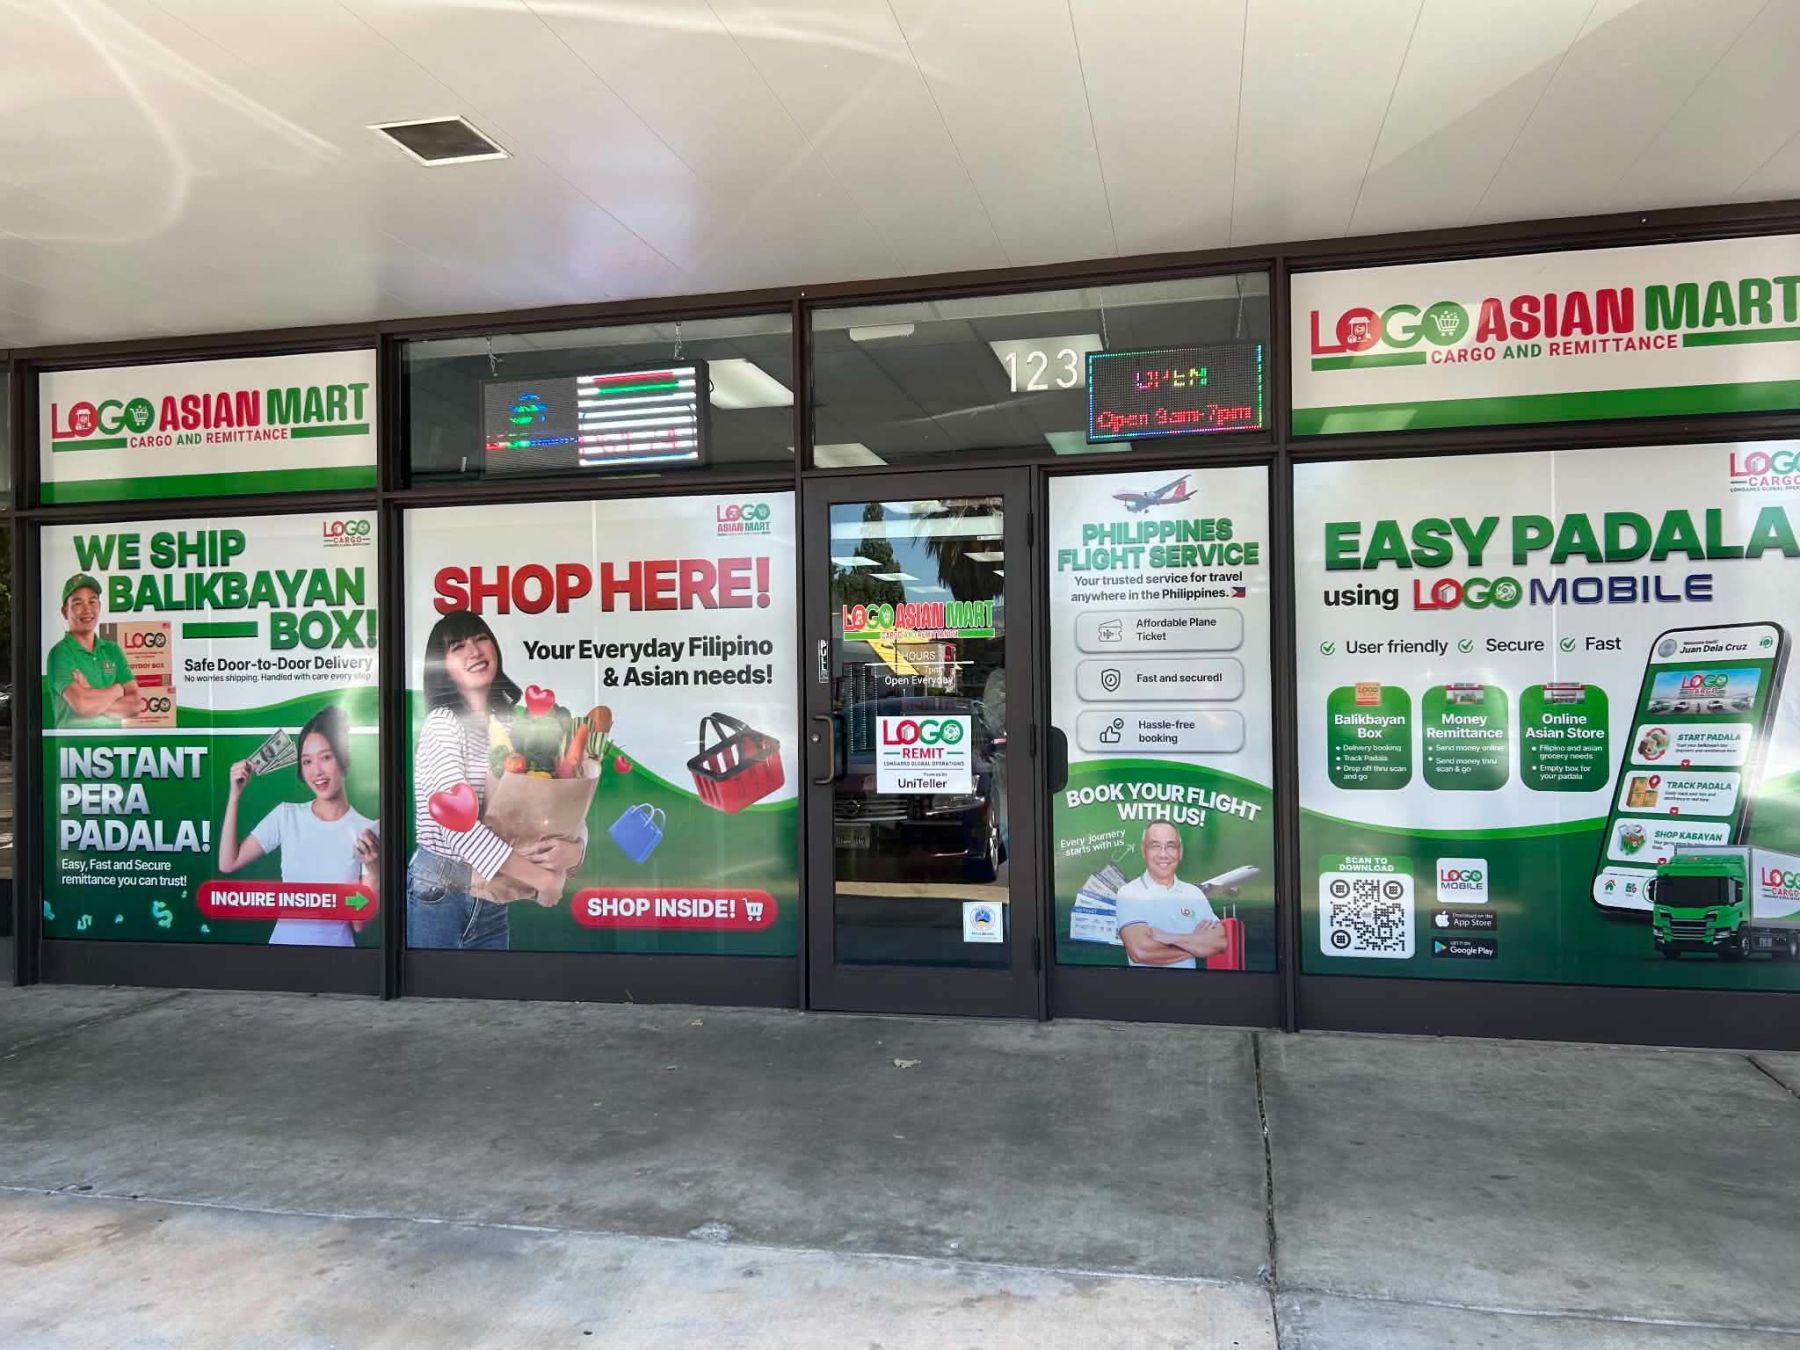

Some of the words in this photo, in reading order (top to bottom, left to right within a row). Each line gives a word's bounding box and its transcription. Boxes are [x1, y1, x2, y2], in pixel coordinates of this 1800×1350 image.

[1311, 300, 1470, 356] LOGO
[1475, 286, 1634, 344] ASIAN
[1644, 276, 1800, 331] MART
[1431, 346, 1496, 364] CARGO
[1502, 344, 1542, 360] AND
[1549, 334, 1678, 357] REMITTANCE
[1006, 349, 1078, 392] 123
[52, 398, 155, 439] LOGO
[160, 390, 260, 432] ASIAN
[267, 383, 369, 425] MART
[1098, 411, 1148, 432] Open
[130, 435, 172, 448] CARGO
[177, 433, 202, 446] AND
[206, 428, 288, 444] REMITTANCE
[717, 504, 770, 522] LOGO
[324, 520, 371, 537] LOGO
[718, 523, 744, 532] ASIAN
[745, 522, 770, 532] MART
[1082, 518, 1233, 546] PHILIPPINES
[333, 536, 362, 544] CARGO
[1324, 516, 1500, 571] EASY
[1512, 506, 1800, 566] PADALA
[73, 533, 141, 571] WE
[150, 529, 246, 568] SHIP
[1058, 546, 1147, 572] FLIGHT
[1149, 542, 1260, 569] SERVICE
[434, 563, 592, 615] SHOP
[600, 556, 771, 612] HERE!
[1074, 576, 1100, 586] Your
[1102, 574, 1144, 586] trusted
[1146, 574, 1188, 584] service
[1190, 572, 1208, 583] for
[1210, 572, 1242, 582] travel
[108, 567, 365, 612] BALIKBAYAN
[1071, 592, 1126, 603] anywhere
[1129, 590, 1140, 600] in
[1141, 590, 1160, 600] the
[1162, 587, 1230, 602] Philippines.
[1324, 584, 1399, 610] using
[1413, 576, 1523, 610] LOGO
[1529, 573, 1714, 606] MOBILE
[842, 603, 894, 631] LOGO
[896, 602, 944, 628] ASIAN
[946, 600, 994, 628] MART
[270, 609, 377, 650] BOX!
[1136, 618, 1188, 628] Affordable
[1190, 618, 1216, 627] Plane
[124, 632, 166, 648] LOGO
[1136, 632, 1166, 642] Ticket
[1585, 636, 1622, 651] Fast
[523, 640, 574, 660] Your
[579, 638, 684, 663] Everyday
[689, 635, 774, 662] Filipino
[1346, 640, 1384, 654] User
[1388, 638, 1448, 656] friendly
[1486, 638, 1544, 652] Secure
[1680, 646, 1702, 654] Juan
[1703, 644, 1723, 652] Dela
[184, 658, 214, 672] Safe
[218, 656, 312, 671] Door-to-Door
[314, 656, 373, 672] Delivery
[184, 674, 194, 682] No
[196, 674, 224, 682] worries
[261, 673, 292, 681] Handled
[294, 672, 310, 680] with
[330, 673, 350, 682] every
[603, 668, 618, 686] &
[623, 665, 688, 686] Asian
[694, 664, 773, 686] needs!
[884, 676, 910, 687] Open
[912, 676, 954, 686] Everyday
[1136, 674, 1158, 683] Fast
[1159, 673, 1178, 683] and
[1180, 672, 1222, 682] secured!
[1682, 674, 1728, 688] LOGO
[1138, 720, 1196, 730] Hassle-free
[1334, 714, 1406, 727] Balikbayan
[1442, 714, 1488, 726] Money
[1542, 713, 1587, 724] Online
[883, 720, 964, 745] LOGO
[1138, 734, 1178, 744] booking
[1358, 728, 1382, 738] Box
[1426, 726, 1504, 738] Remittance
[1526, 727, 1564, 738] Asian
[1567, 728, 1605, 738] Store
[902, 748, 944, 758] REMIT
[1343, 744, 1372, 752] Delivery
[1540, 744, 1566, 752] Filipino
[1566, 744, 1582, 752] and
[60, 746, 208, 779] INSTANT
[898, 778, 947, 788] UniTeller
[1697, 782, 1732, 790] PADALA
[60, 784, 150, 815] PERA
[1066, 783, 1125, 808] BOOK
[1126, 782, 1184, 802] YOUR
[1187, 788, 1262, 822] FLIGHT
[1117, 804, 1170, 820] WITH
[1173, 808, 1206, 828] US!
[60, 820, 210, 853] PADALA!
[1654, 830, 1678, 838] SHOP
[1679, 832, 1722, 841] KABAYAN
[1060, 838, 1085, 849] Every
[1066, 846, 1091, 856] starts
[1092, 840, 1112, 851] with
[62, 859, 88, 872] Easy,
[90, 859, 111, 870] Fast
[113, 859, 133, 870] and
[134, 860, 171, 871] Secure
[1338, 864, 1394, 872] DOWNLOAD
[62, 874, 115, 886] remittance
[117, 876, 138, 888] you
[139, 877, 158, 886] can
[159, 875, 187, 886] trust!
[1440, 869, 1482, 882] LOGO
[1440, 882, 1483, 890] MOBILE
[211, 890, 276, 908] INQUIRE
[278, 892, 337, 908] INSIDE!
[588, 898, 650, 918] SHOP
[655, 898, 736, 918] INSIDE!
[1454, 918, 1470, 928] App
[1472, 918, 1492, 926] Store
[1450, 946, 1478, 956] Google
[1478, 946, 1494, 956] Play
